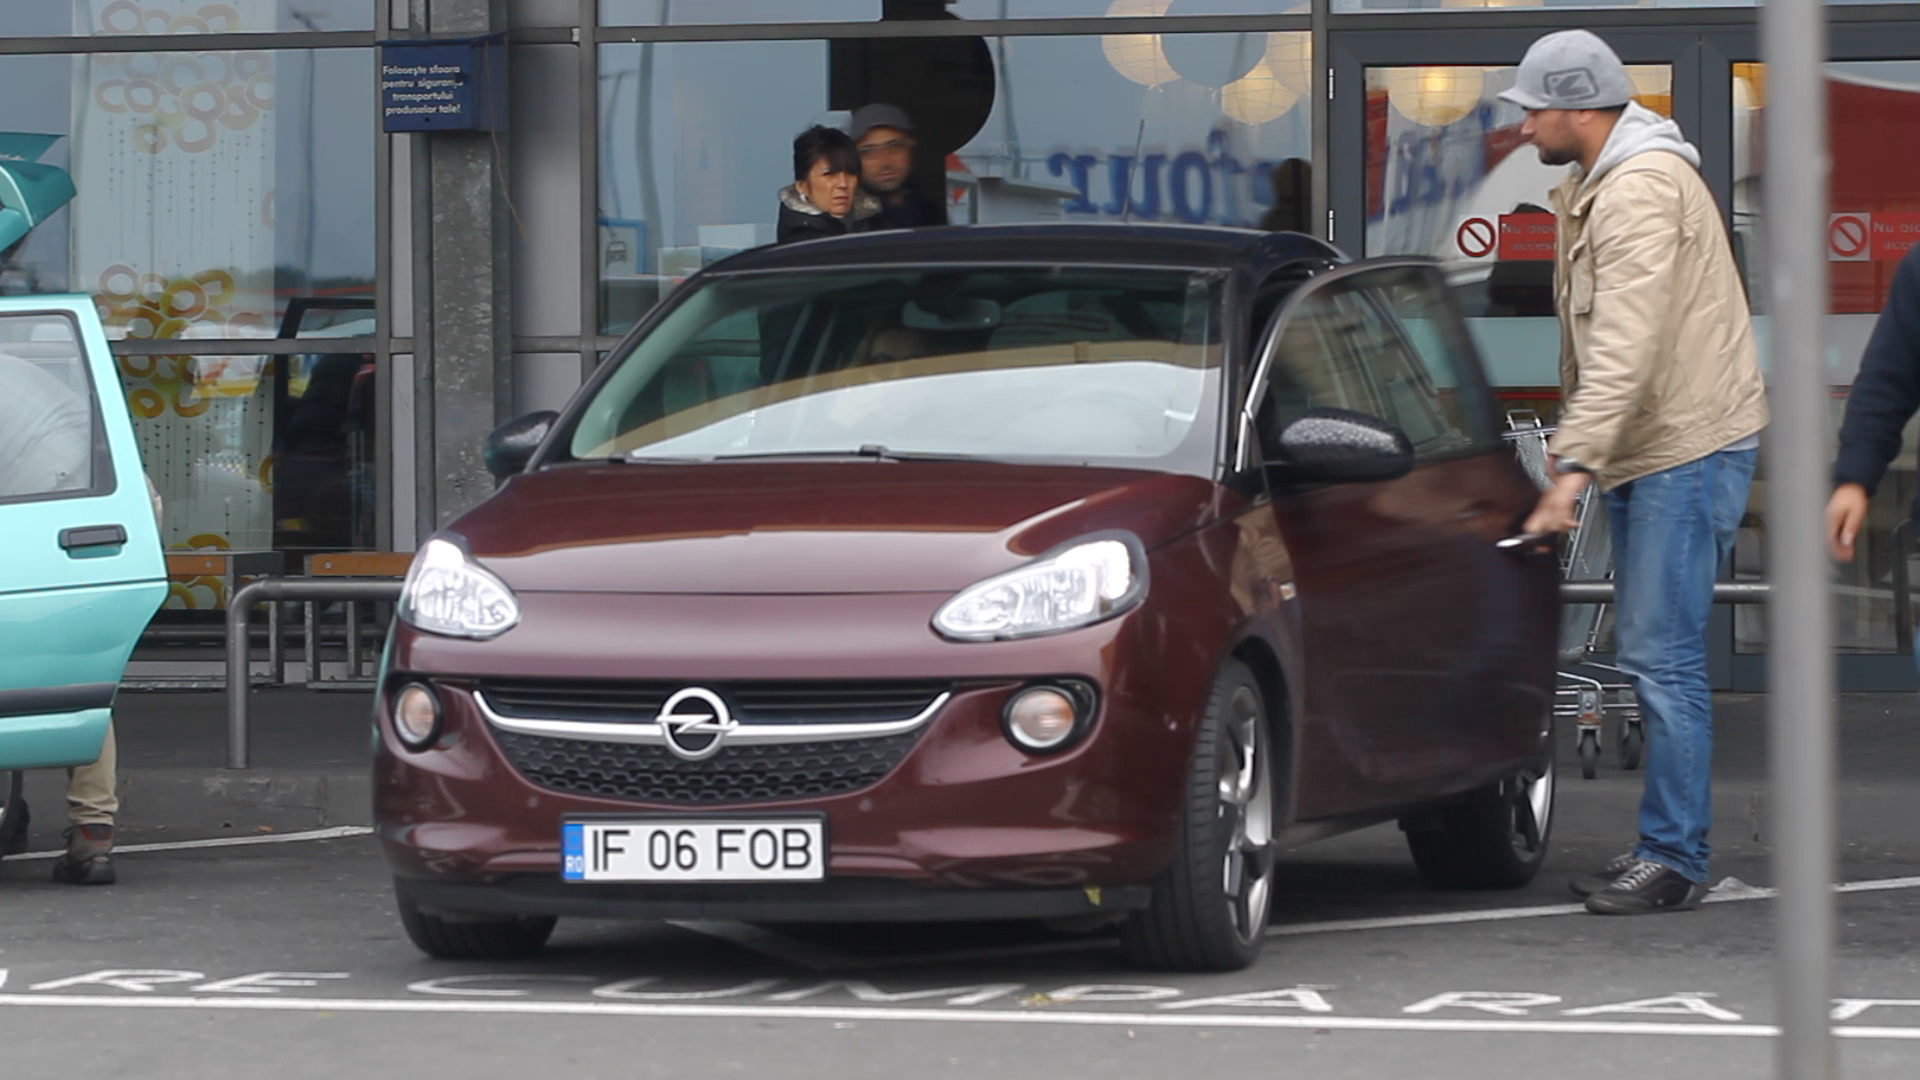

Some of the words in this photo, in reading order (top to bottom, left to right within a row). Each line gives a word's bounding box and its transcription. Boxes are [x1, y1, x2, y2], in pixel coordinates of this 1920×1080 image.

[429, 64, 460, 74] sfoara
[382, 80, 414, 90] pentru
[392, 90, 454, 103] transportului
[385, 104, 437, 116] produselor
[1501, 223, 1522, 234] Nu
[1873, 222, 1894, 233] Nu
[593, 829, 630, 872] IF
[649, 829, 697, 871] 06
[716, 828, 812, 871] FOB
[565, 856, 583, 873] RO
